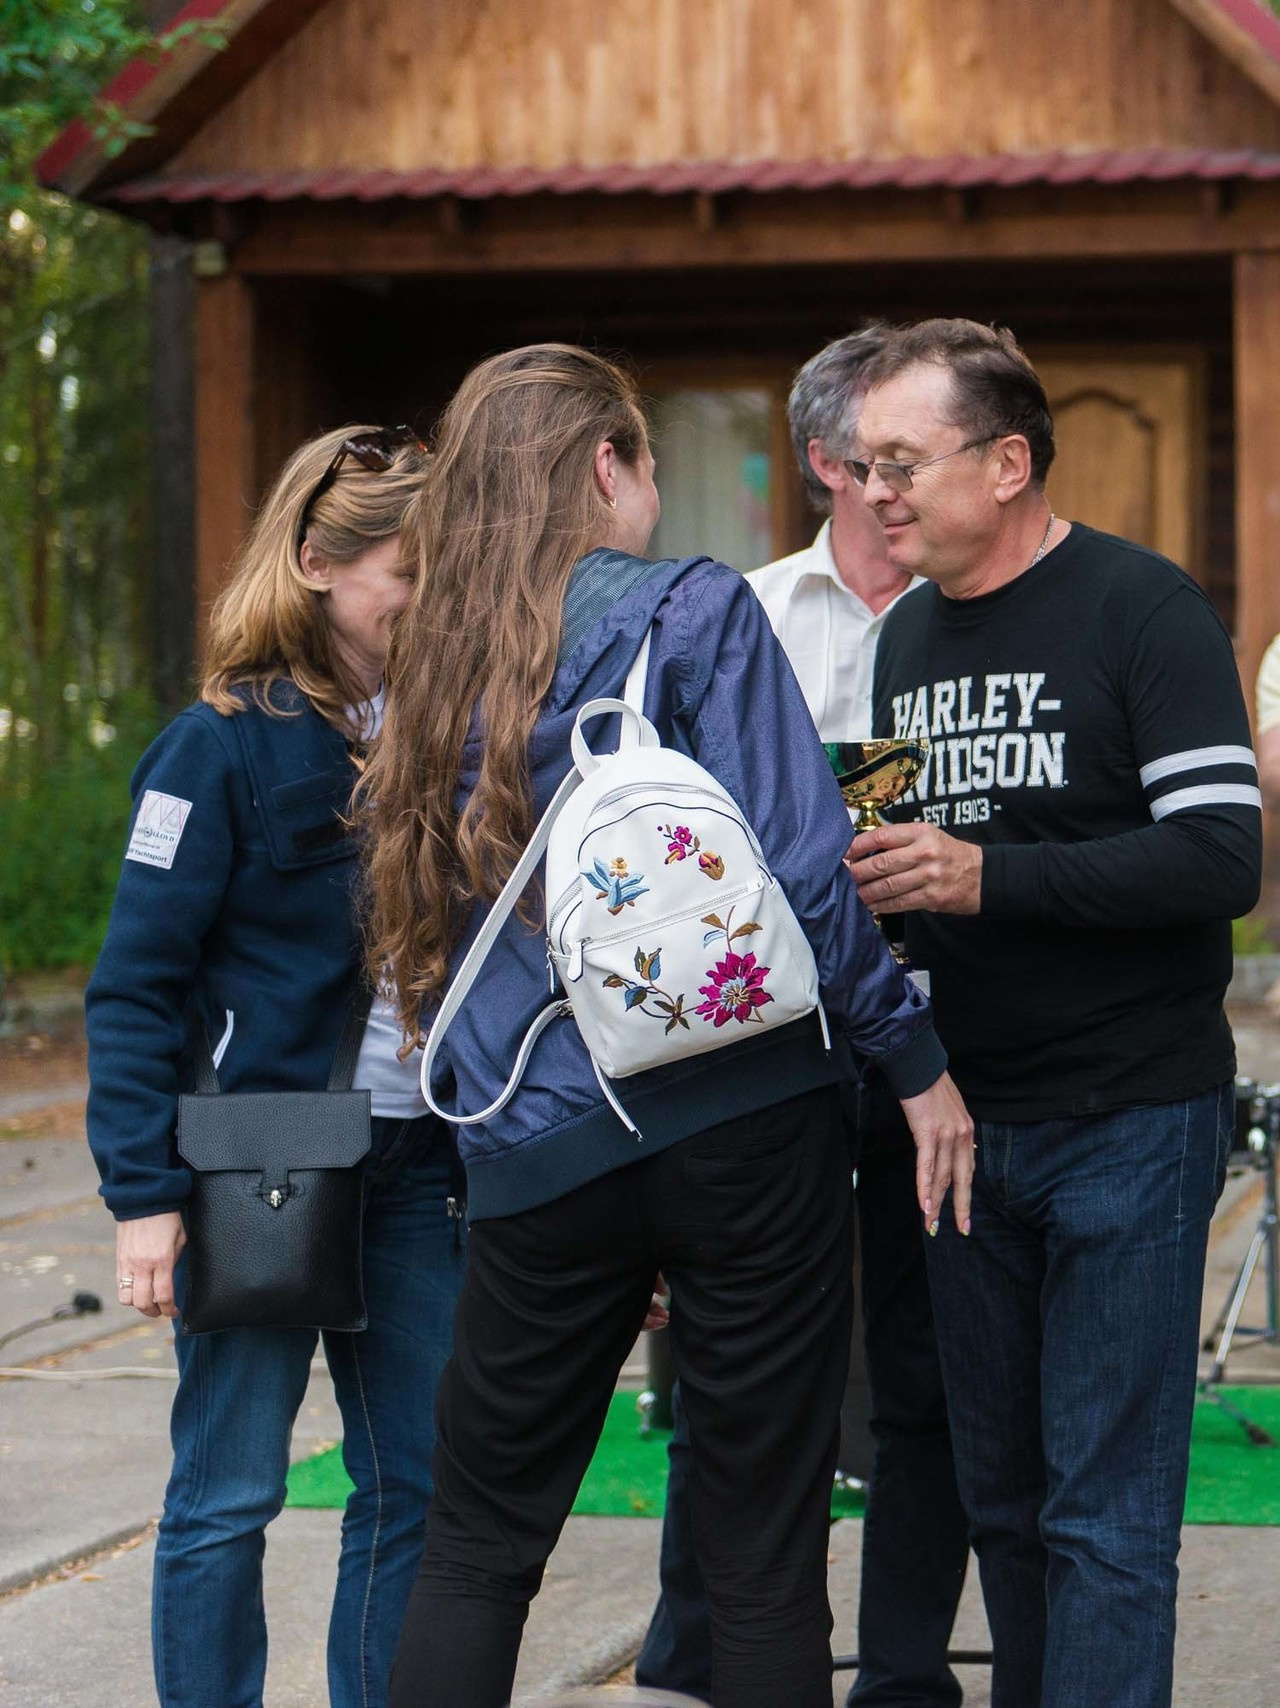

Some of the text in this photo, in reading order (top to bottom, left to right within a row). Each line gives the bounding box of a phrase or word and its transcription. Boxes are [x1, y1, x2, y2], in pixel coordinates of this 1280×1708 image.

[892, 672, 1062, 739] HARLEY-
[922, 802, 949, 827] EST
[953, 797, 991, 825] 1903
